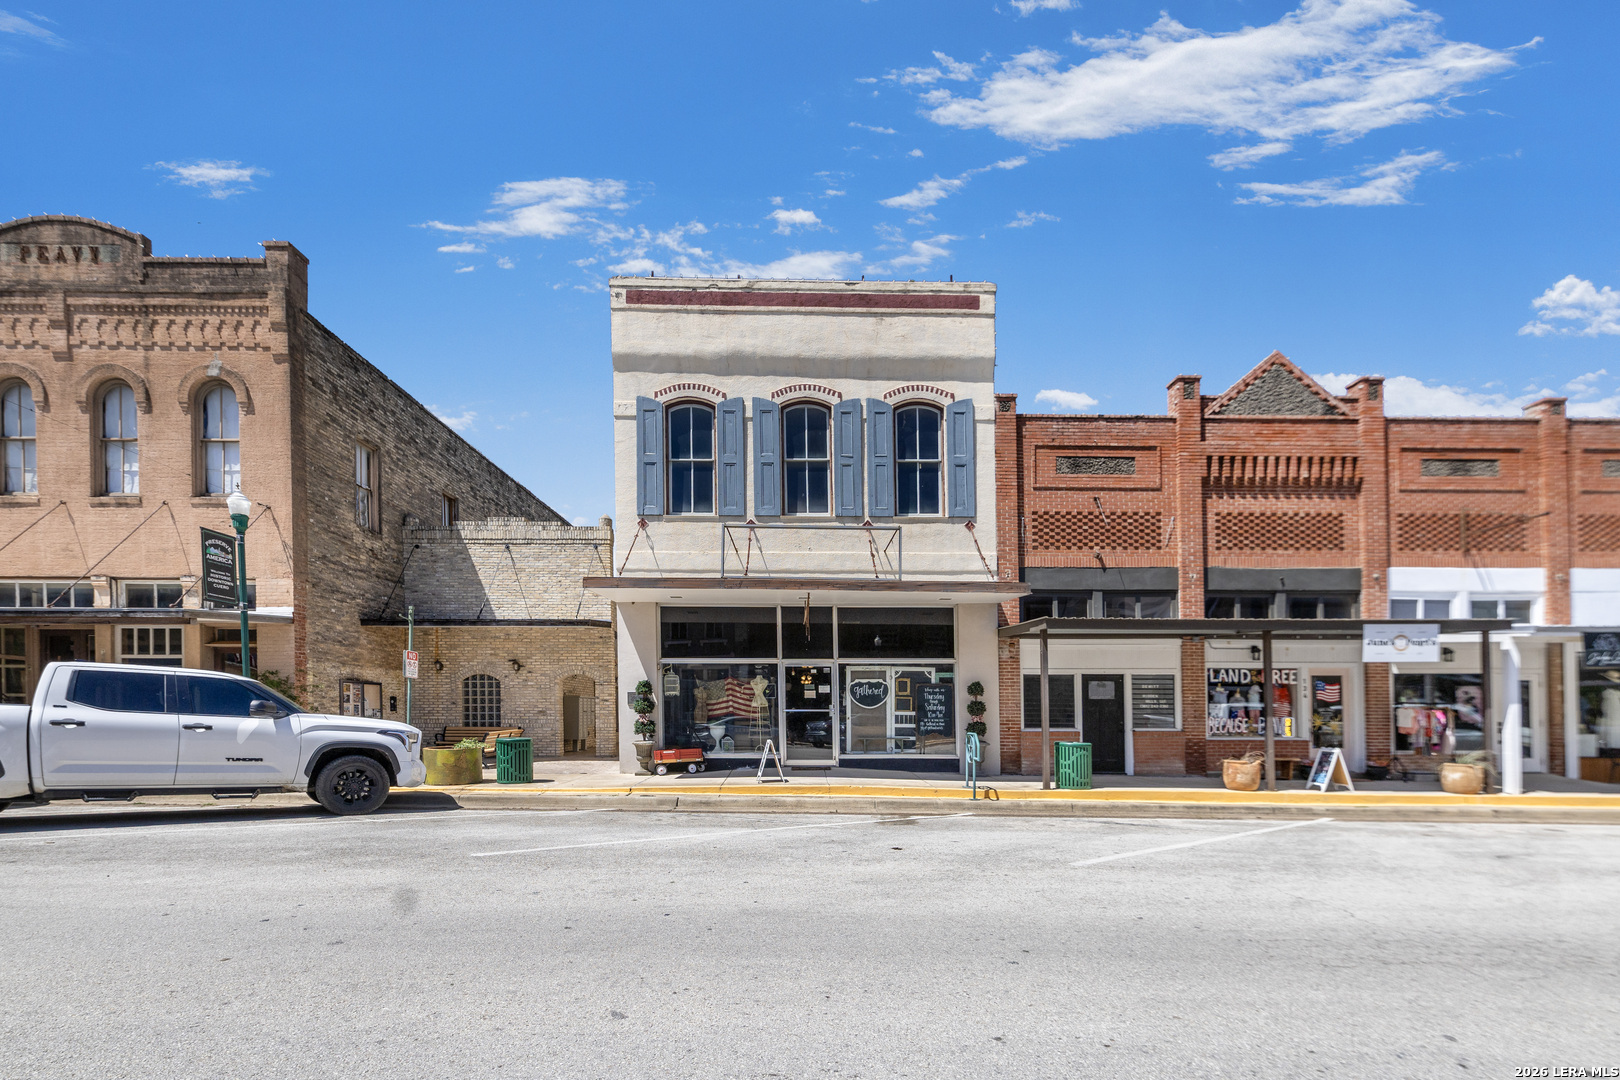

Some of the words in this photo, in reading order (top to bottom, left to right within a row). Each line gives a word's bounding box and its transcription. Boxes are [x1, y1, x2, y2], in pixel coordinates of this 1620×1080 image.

[205, 539, 232, 552] PRESERVE
[206, 553, 233, 564] AMERICA
[408, 652, 416, 660] NO
[1209, 669, 1251, 683] LAND
[1266, 670, 1298, 684] REE
[854, 684, 885, 698] gathered
[924, 692, 945, 702] Thursday
[1208, 717, 1248, 734] BECAUSE
